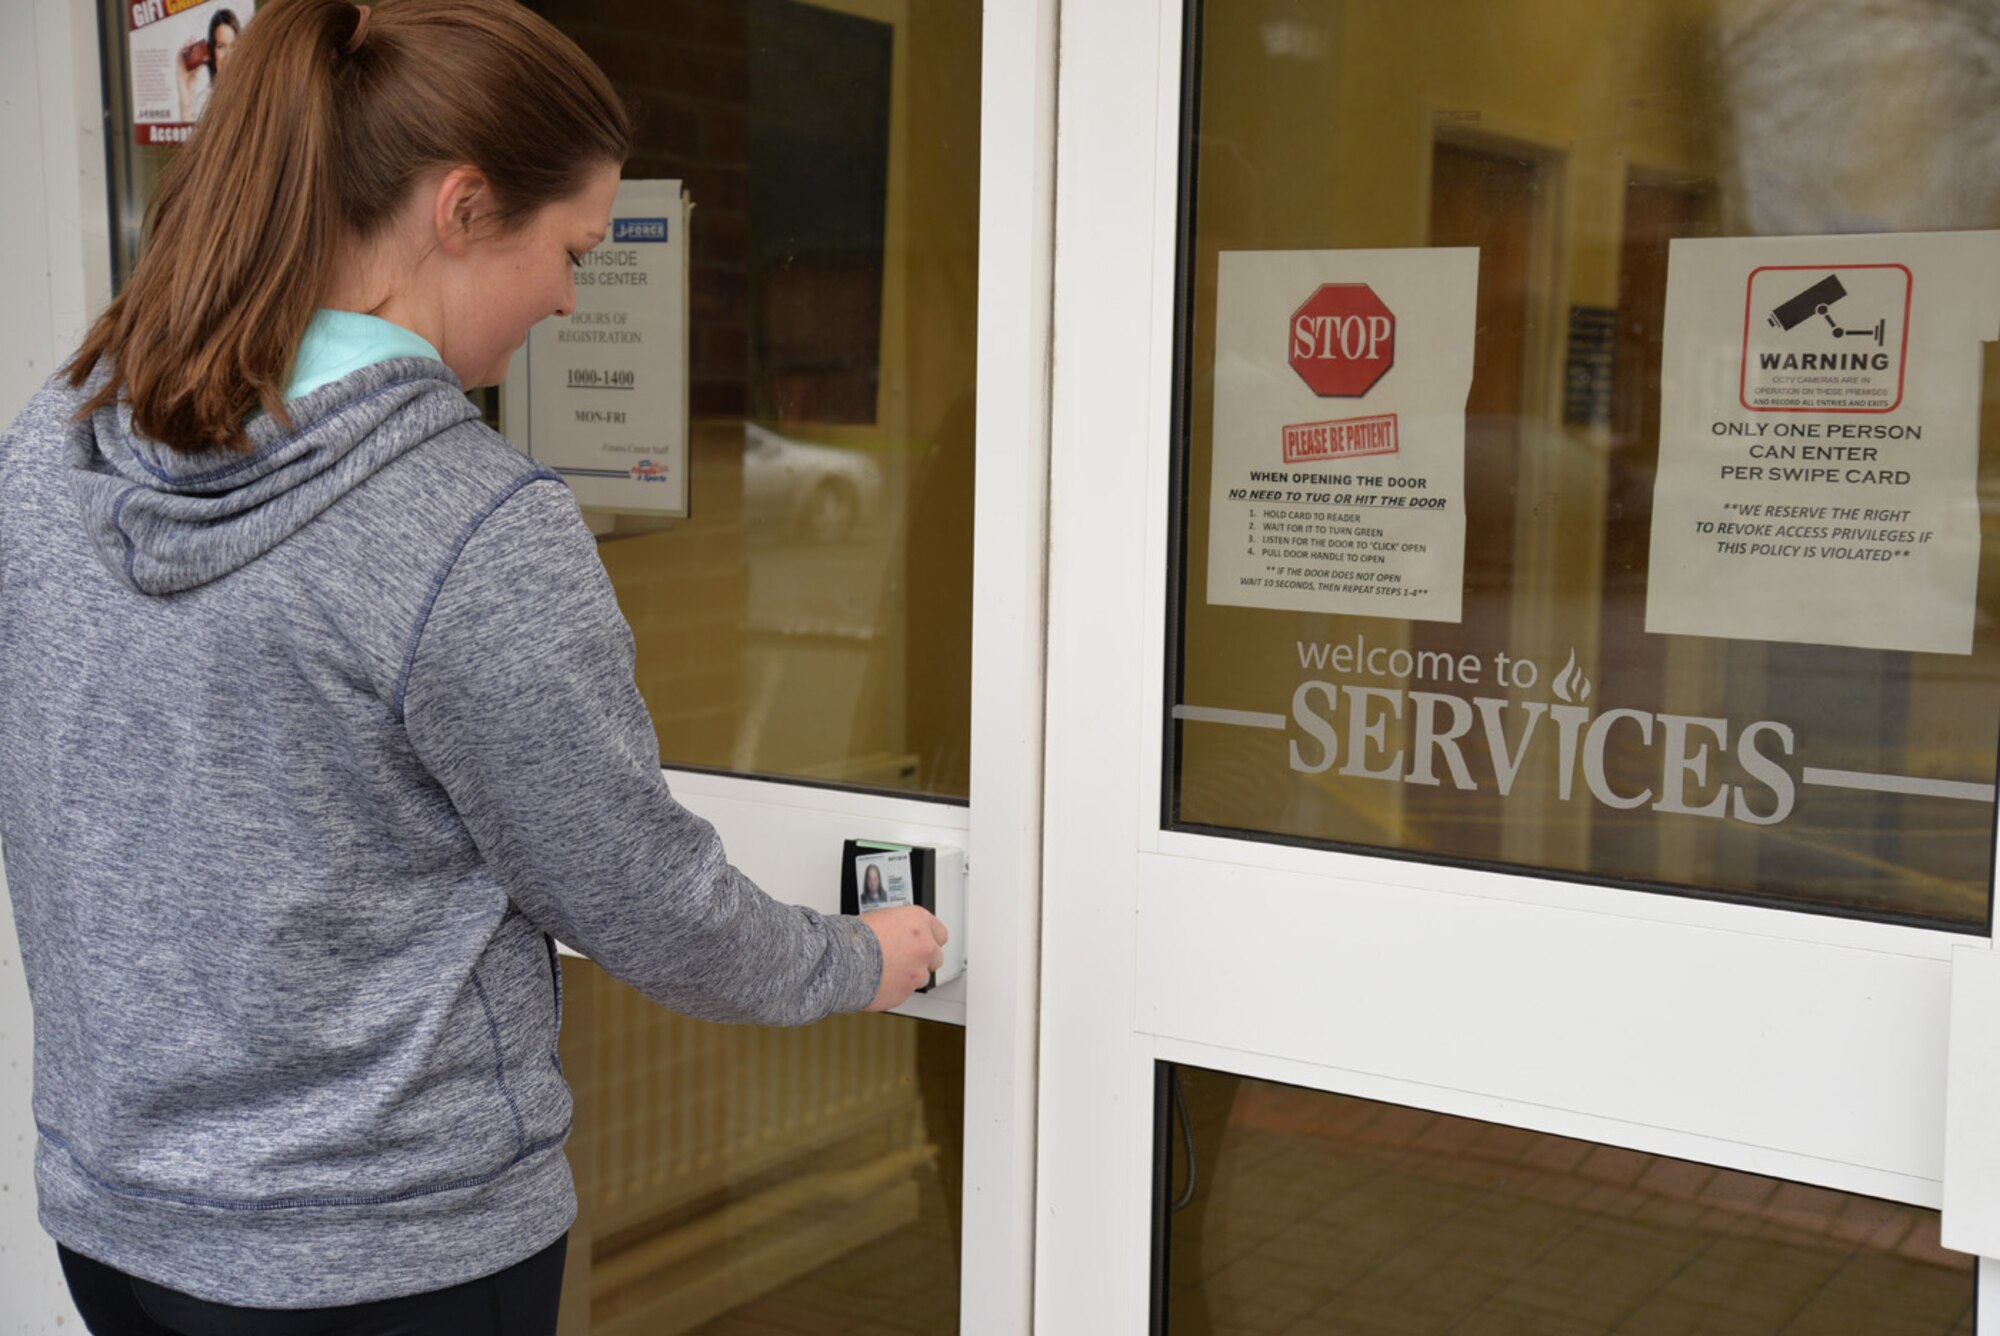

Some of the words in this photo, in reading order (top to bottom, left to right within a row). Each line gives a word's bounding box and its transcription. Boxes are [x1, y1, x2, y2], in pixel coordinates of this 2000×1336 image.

[132, 0, 165, 28] GIFT
[598, 272, 648, 286] CENTER
[571, 312, 611, 325] HOURS
[613, 312, 628, 325] OF
[558, 330, 642, 344] REGISTRATION
[1294, 315, 1391, 360] STOP
[1760, 353, 1889, 371] WARNING
[567, 369, 635, 386] 1000-1400
[1772, 376, 1796, 384] CCTV
[1796, 376, 1839, 384] CAMERAS
[1840, 376, 1858, 384] ARE
[1860, 376, 1871, 384] IN
[1754, 387, 1800, 396] OPERATION
[1802, 388, 1814, 396] ON
[1816, 388, 1842, 396] THESE
[1844, 388, 1888, 397] PREMISES
[1753, 398, 1770, 406] AND
[1771, 398, 1800, 406] RECORD
[1816, 399, 1847, 407] ENTRIES
[1868, 400, 1889, 408] EXITS
[575, 410, 626, 424] MON-FRI
[1288, 430, 1328, 456] PLEASE
[1329, 426, 1345, 452] BE
[1347, 421, 1391, 450] PATIENT
[1711, 422, 1770, 437] ONLY
[1774, 423, 1822, 438] ONE
[1826, 424, 1922, 440] PERSON
[1749, 444, 1796, 460] CAN
[1802, 446, 1878, 462] ENTER
[1250, 471, 1288, 482] WHEN
[1292, 473, 1352, 486] OPENING
[1356, 476, 1384, 487] THE
[1388, 477, 1427, 488] DOOR
[1720, 465, 1763, 481] PER
[1768, 467, 1840, 483] SWIPE
[1845, 469, 1911, 486] CARD
[1228, 488, 1247, 499] NO
[1249, 490, 1282, 500] NEED
[1286, 492, 1302, 501] TO
[1305, 492, 1331, 502] TUG
[1334, 494, 1352, 504] OR
[1354, 495, 1378, 505] HIT
[1380, 496, 1407, 506] THE
[1409, 497, 1447, 508] DOOR
[1249, 509, 1256, 518] 1.
[1263, 510, 1287, 520] HOLD
[1288, 511, 1312, 520] CARD
[1314, 512, 1325, 521] TO
[1326, 513, 1361, 523] READER
[1764, 504, 1828, 520] RESERVE
[1831, 507, 1860, 521] THE
[1864, 508, 1911, 524] RIGHT
[1248, 522, 1256, 530] 2.
[1262, 522, 1285, 532] WAIT
[1286, 524, 1304, 533] FOR
[1305, 525, 1314, 533] IT
[1315, 526, 1326, 534] TO
[1328, 526, 1352, 536] TURN
[1354, 528, 1384, 537] GREEN
[1696, 521, 1714, 534] TO
[1716, 522, 1772, 537] REVOKE
[1775, 525, 1829, 540] ACCESS
[1832, 527, 1916, 544] PRIVILEGES
[1919, 530, 1934, 544] IF
[1262, 536, 1290, 545] LISTEN
[1290, 537, 1308, 546] FOR
[1310, 538, 1326, 547] THE
[1328, 539, 1354, 549] DOOR
[1356, 540, 1368, 550] TO
[1400, 543, 1426, 552] OPEN
[1716, 541, 1747, 555] THIS
[1750, 543, 1801, 558] POLICY
[1803, 546, 1817, 559] IS
[1262, 548, 1282, 558] PULL
[1283, 550, 1308, 559] DOOR
[1310, 552, 1344, 561] HANDLE
[1346, 554, 1358, 562] TO
[1360, 554, 1385, 564] OPEN
[1276, 566, 1285, 575] IF
[1286, 568, 1303, 576] THE
[1304, 568, 1330, 578] DOOR
[1331, 570, 1354, 580] DOES
[1356, 572, 1375, 581] NOT
[1376, 574, 1402, 582] OPEN
[1240, 577, 1262, 586] WAIT
[1263, 578, 1274, 587] 10
[1274, 580, 1315, 592] SECONDS,
[1318, 582, 1342, 592] THEN
[1342, 584, 1374, 594] REPEAT
[1375, 586, 1402, 596] STEPS
[1297, 634, 1481, 685] welcome
[1494, 651, 1539, 689] to
[1288, 679, 1796, 826] SERVICES
